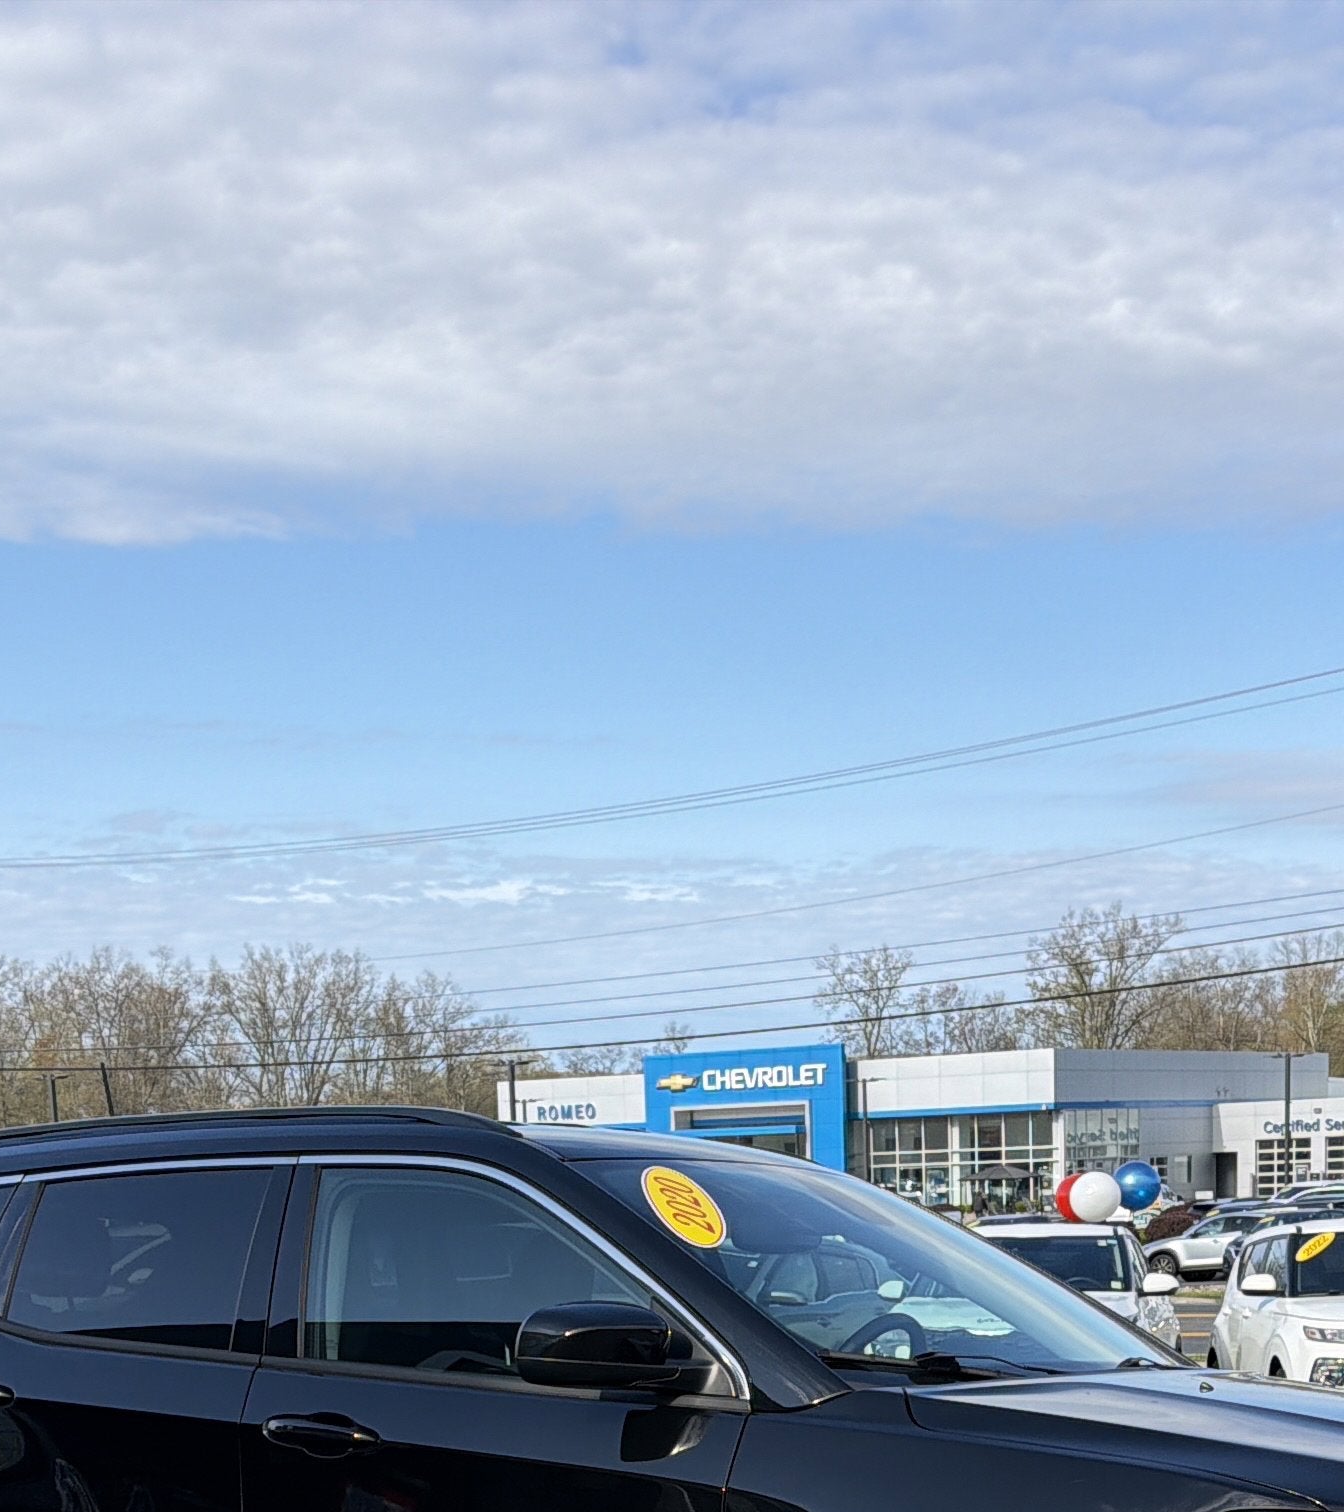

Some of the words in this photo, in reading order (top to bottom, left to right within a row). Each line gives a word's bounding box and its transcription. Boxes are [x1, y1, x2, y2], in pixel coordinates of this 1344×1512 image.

[702, 1064, 827, 1091] CHEVROLET
[536, 1103, 597, 1121] ROMEO
[1263, 1117, 1321, 1136] Cerified
[653, 1176, 716, 1234] 2020
[1302, 1234, 1330, 1257] 2022
